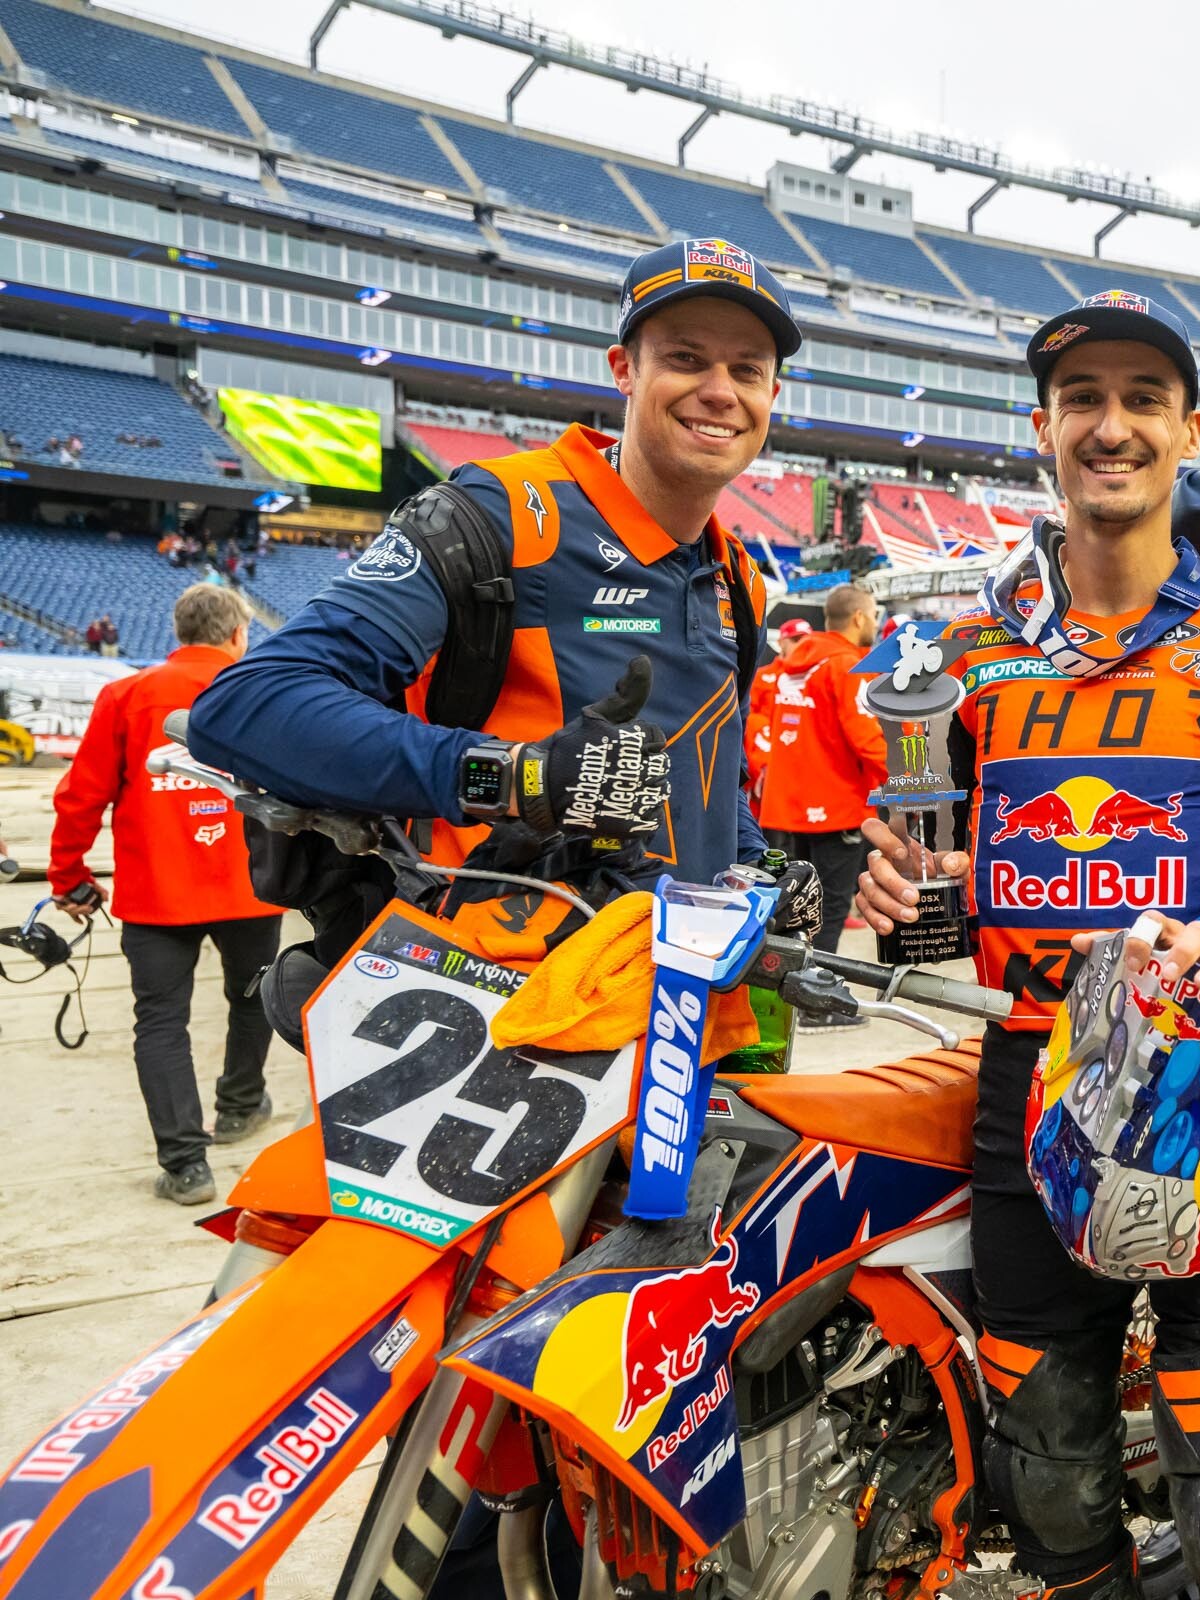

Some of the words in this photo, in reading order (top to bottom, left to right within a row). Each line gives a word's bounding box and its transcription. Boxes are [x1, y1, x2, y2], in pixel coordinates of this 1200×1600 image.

[688, 251, 720, 265] Red
[723, 255, 752, 276] Bull
[703, 268, 740, 284] KTM
[367, 547, 412, 567] WINGS
[592, 587, 650, 605] WP
[603, 619, 659, 632] MOTOREX
[1100, 671, 1157, 681] RENTHAL
[563, 742, 608, 829] Mechanix
[600, 728, 646, 821] Mechanix
[990, 857, 1081, 910] Red
[1086, 856, 1187, 910] Bull
[920, 904, 945, 914] place
[921, 894, 940, 903] 0SX
[900, 927, 928, 936] Gillette
[929, 925, 959, 935] Stadium
[901, 937, 947, 946] Foxborough,
[947, 935, 959, 944] MA
[905, 948, 924, 957] April
[925, 947, 937, 957] 23,
[938, 946, 957, 954] 2022
[361, 959, 392, 975] AMA
[393, 942, 441, 967] AMA
[465, 958, 529, 989] MONS
[1003, 939, 1092, 1003] KT
[474, 981, 511, 998] ENE
[1090, 943, 1113, 1015] AIROH
[640, 984, 702, 1177] 100%
[318, 988, 620, 1208] 25
[359, 1195, 455, 1240] MOTOREX
[91, 1349, 196, 1412] Red
[647, 1409, 694, 1473] Red
[693, 1364, 731, 1424] Bull
[10, 1407, 128, 1482] Bull
[1121, 1439, 1158, 1464] NTHA
[197, 1445, 302, 1550] Red
[275, 1386, 359, 1472] Bull
[680, 1433, 737, 1508] KTM
[496, 1502, 517, 1511] Air
[615, 1586, 633, 1598] Air
